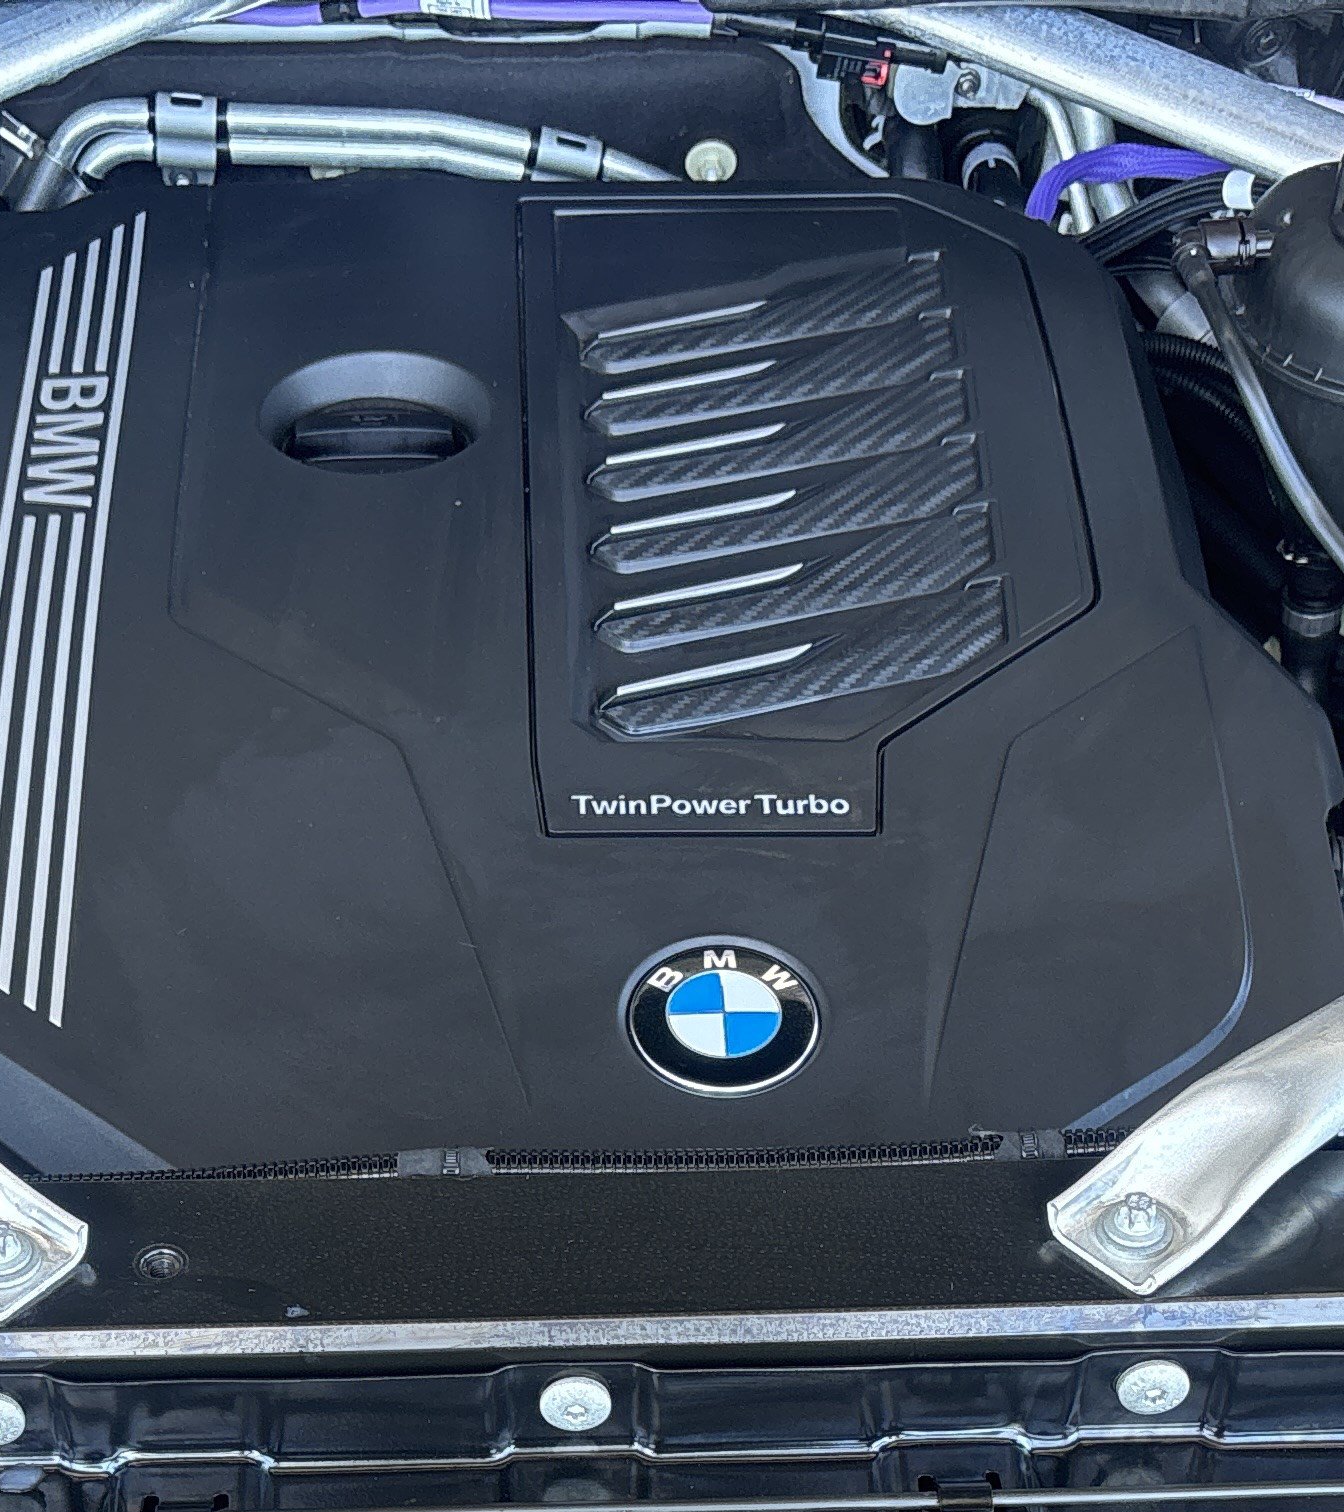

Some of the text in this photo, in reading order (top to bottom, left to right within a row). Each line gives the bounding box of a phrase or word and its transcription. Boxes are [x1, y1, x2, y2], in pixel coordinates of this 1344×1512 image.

[23, 376, 109, 508] BMW
[571, 794, 850, 816] TwinPower Turbo
[646, 949, 798, 993] BMW
